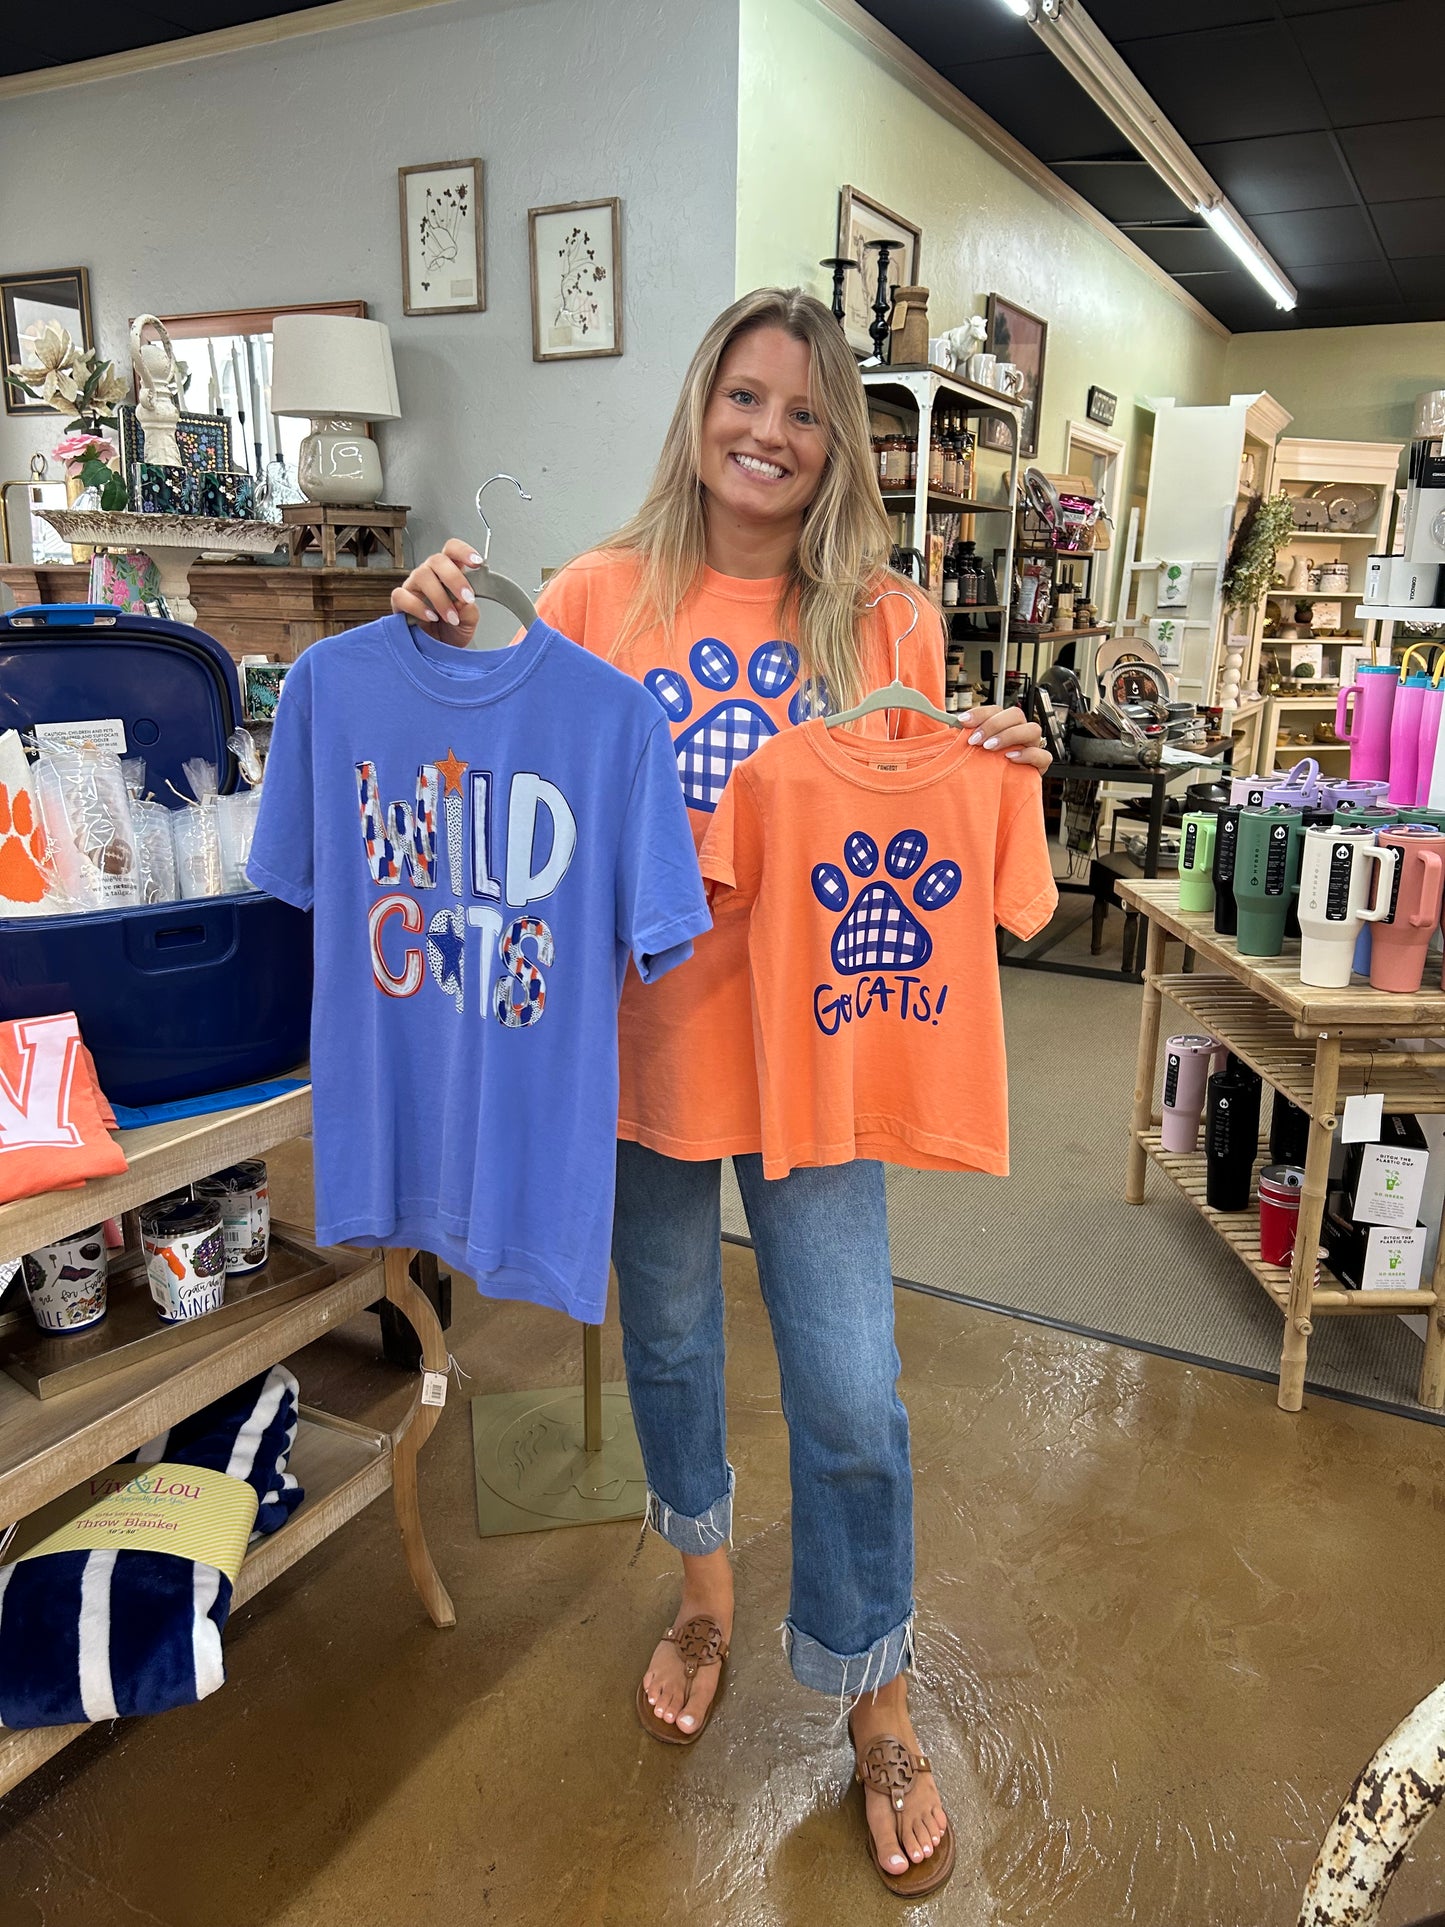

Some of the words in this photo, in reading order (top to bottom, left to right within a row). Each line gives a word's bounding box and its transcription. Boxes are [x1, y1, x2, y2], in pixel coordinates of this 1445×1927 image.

[354, 747, 578, 909] WILD
[855, 975, 949, 1026] CATS!
[1379, 1153, 1399, 1161] DITCH
[76, 1519, 120, 1530] Throw
[124, 1517, 179, 1531] Blanket
